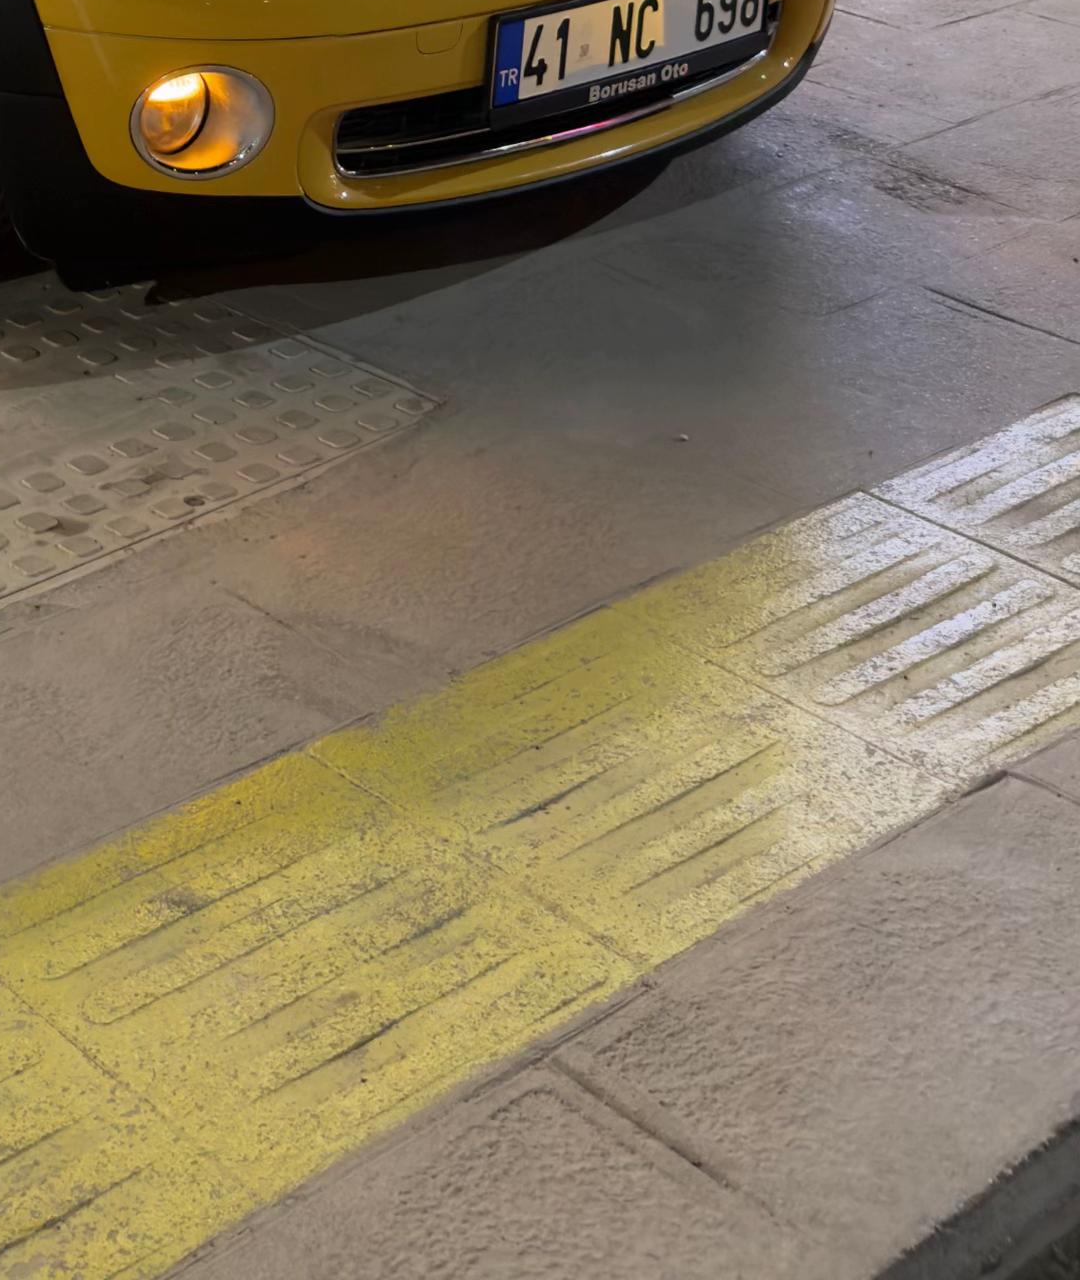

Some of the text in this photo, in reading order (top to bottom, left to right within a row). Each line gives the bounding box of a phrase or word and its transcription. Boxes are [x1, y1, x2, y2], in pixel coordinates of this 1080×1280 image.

[522, 18, 571, 86] 41
[499, 68, 519, 88] TR
[588, 61, 689, 104] Borusan Oto
